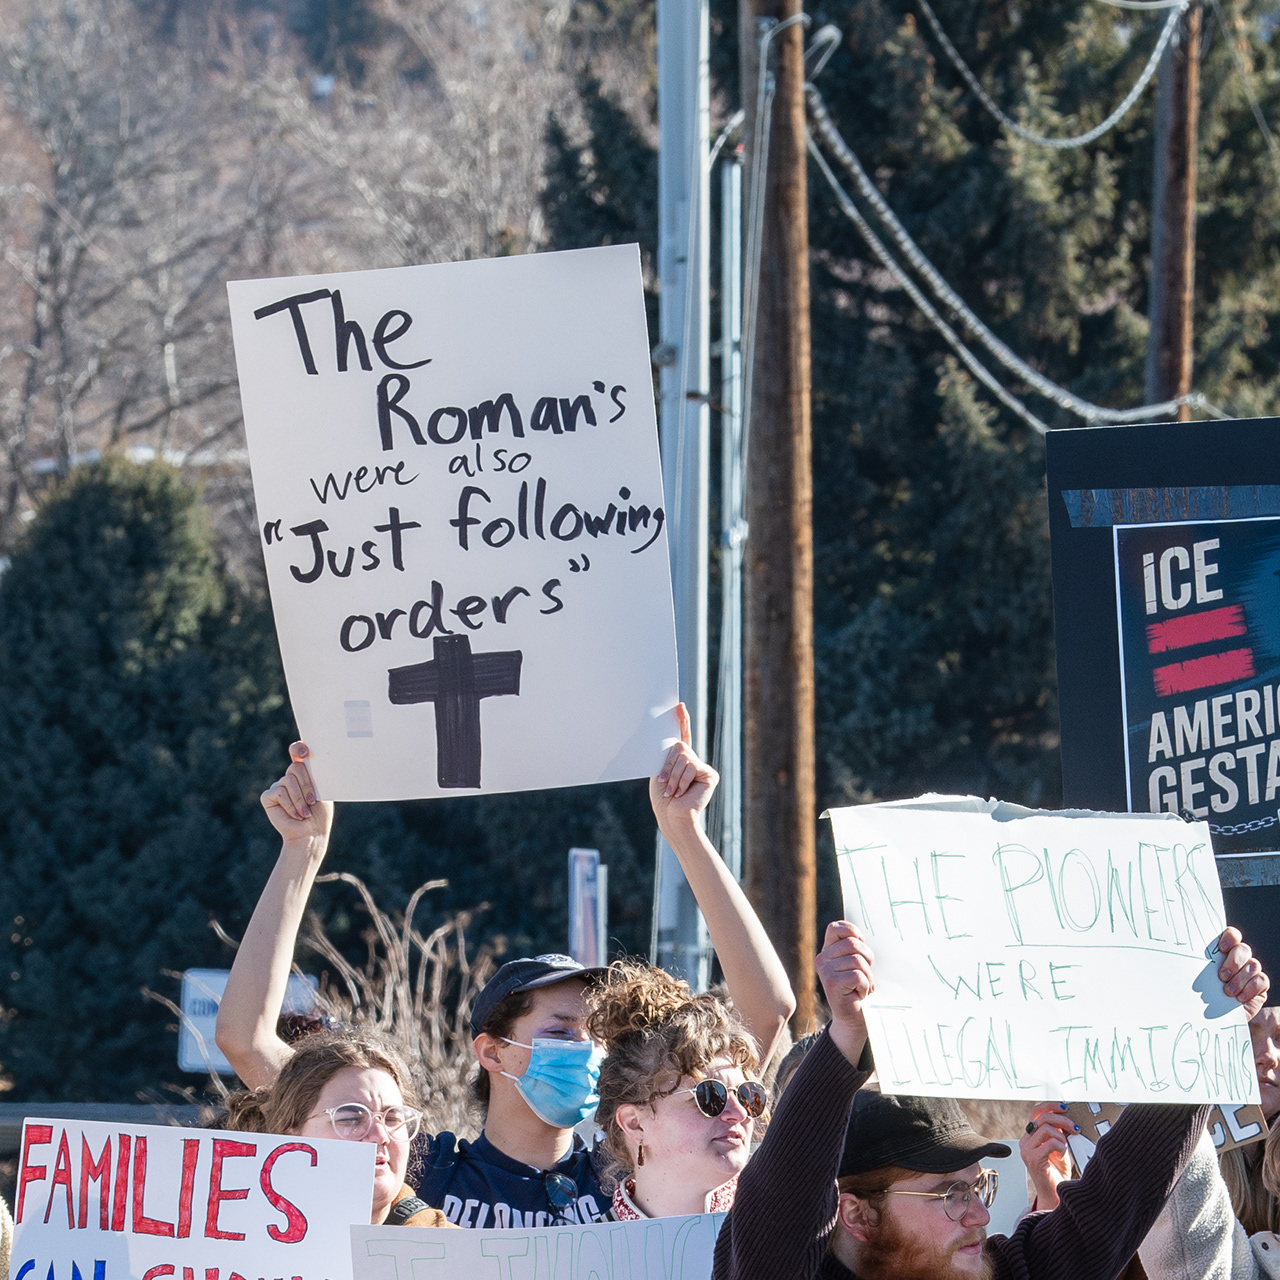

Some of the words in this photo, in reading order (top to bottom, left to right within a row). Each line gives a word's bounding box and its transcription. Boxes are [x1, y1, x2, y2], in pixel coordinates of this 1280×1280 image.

[254, 288, 432, 375] The
[377, 373, 627, 450] Roman's
[310, 459, 420, 504] were
[448, 443, 532, 477] also
[263, 507, 422, 584] "Just
[450, 477, 665, 554] following
[340, 554, 590, 652] orders"
[1142, 538, 1223, 615] ICE
[837, 842, 974, 941] THE
[928, 955, 1083, 1001] WERE
[870, 1004, 1042, 1090] ILLEGAL
[1048, 1020, 1255, 1104] IMMIGRANTS
[17, 1124, 319, 1244] FAMILIES
[442, 1195, 601, 1229] BELONG
